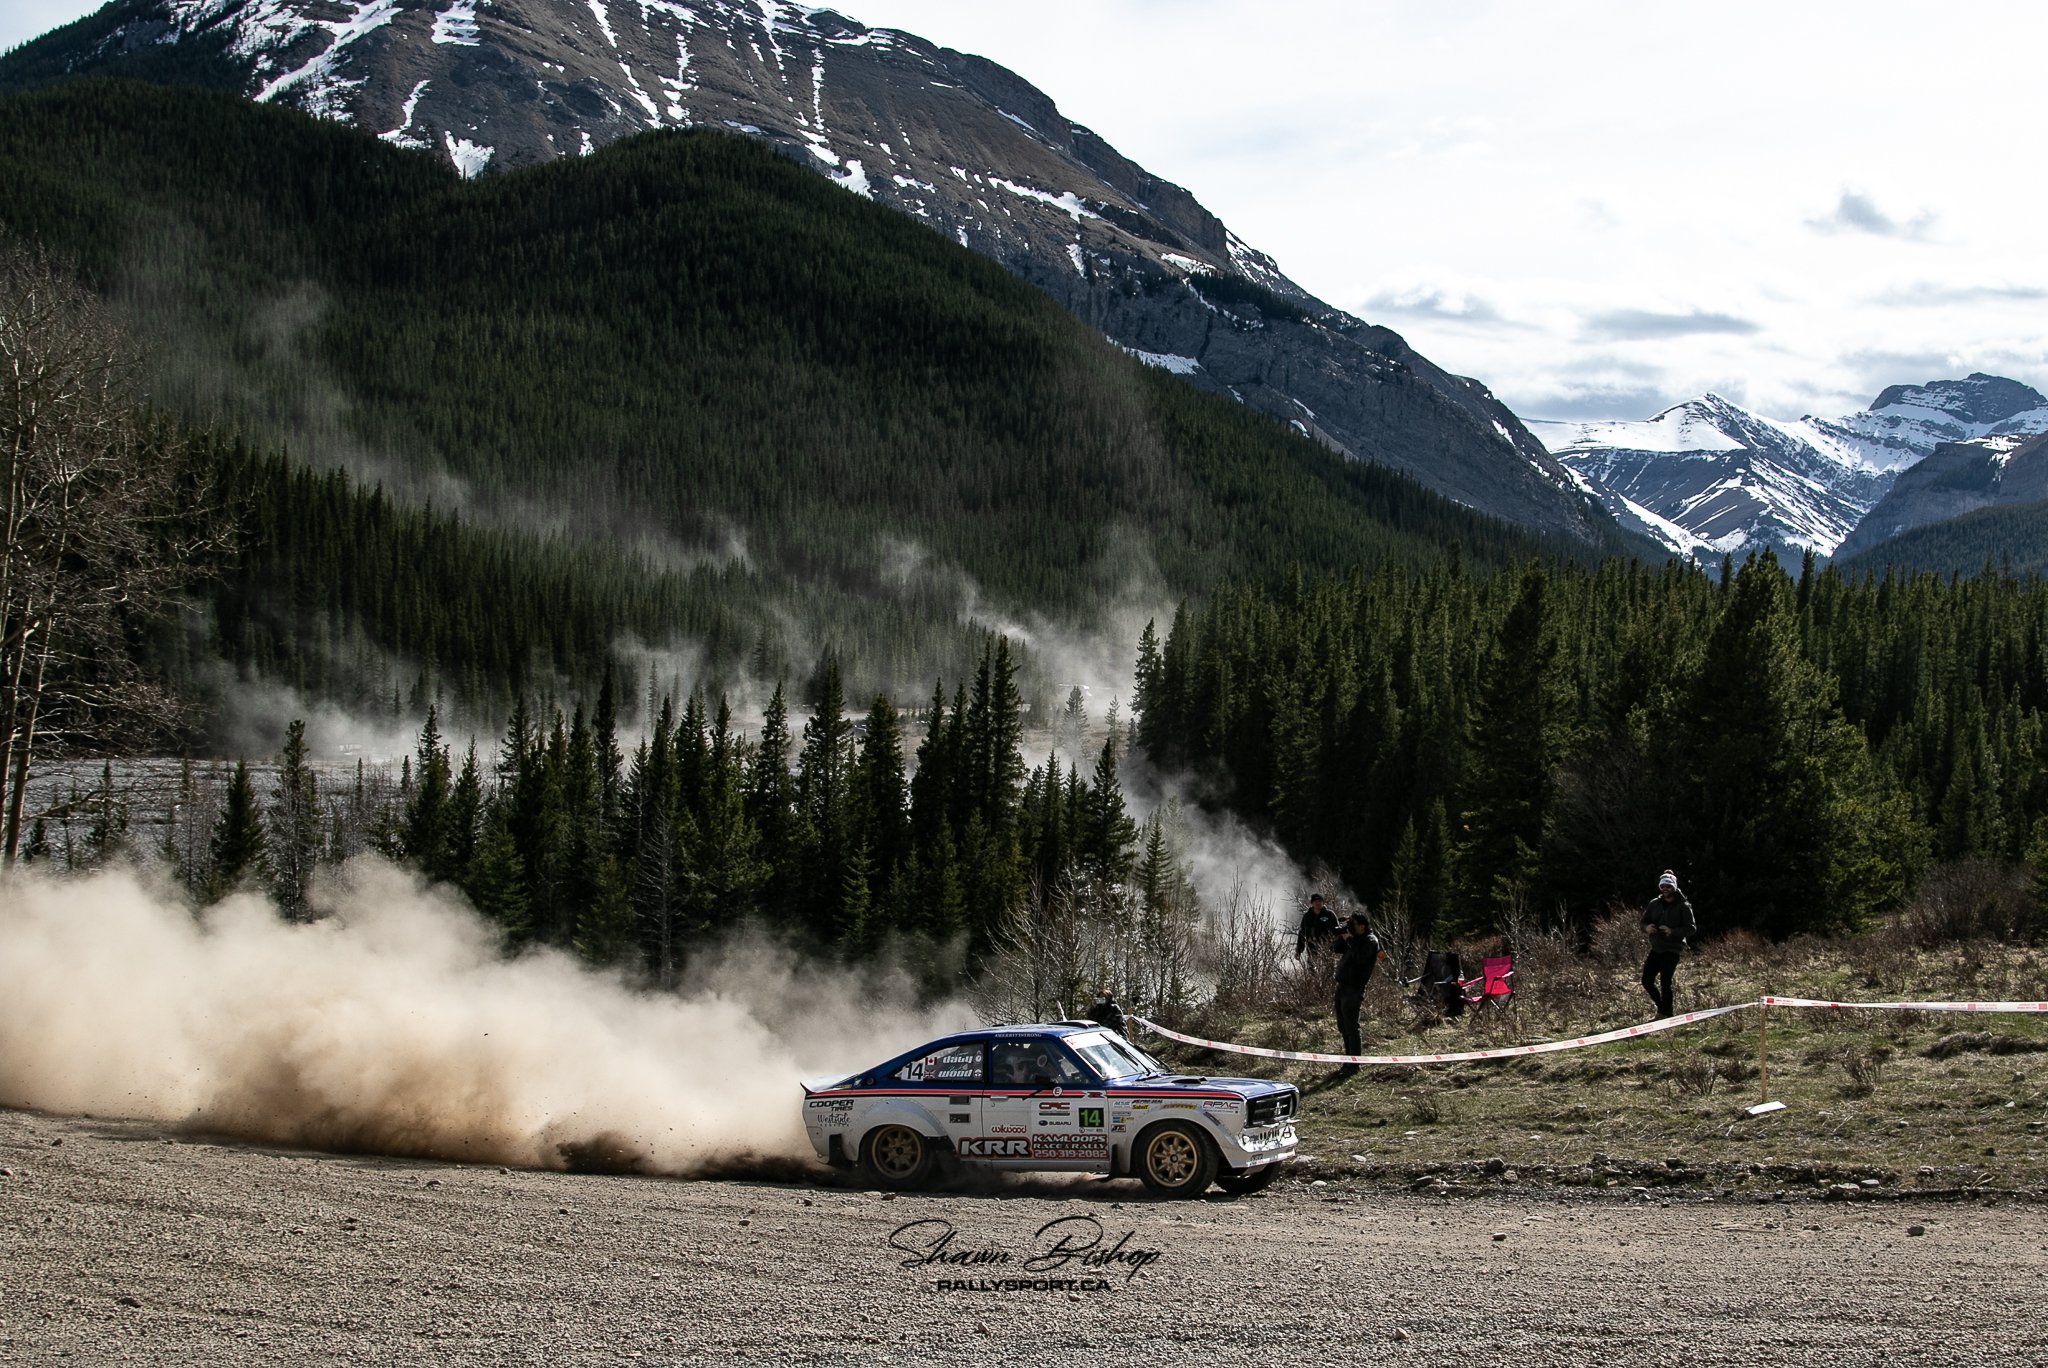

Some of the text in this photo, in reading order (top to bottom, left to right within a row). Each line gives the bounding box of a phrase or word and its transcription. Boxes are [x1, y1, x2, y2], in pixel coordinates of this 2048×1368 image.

[905, 1062, 923, 1079] 14
[809, 1100, 854, 1108] COOPER
[1080, 1109, 1101, 1127] 14
[961, 1140, 1029, 1155] KRR
